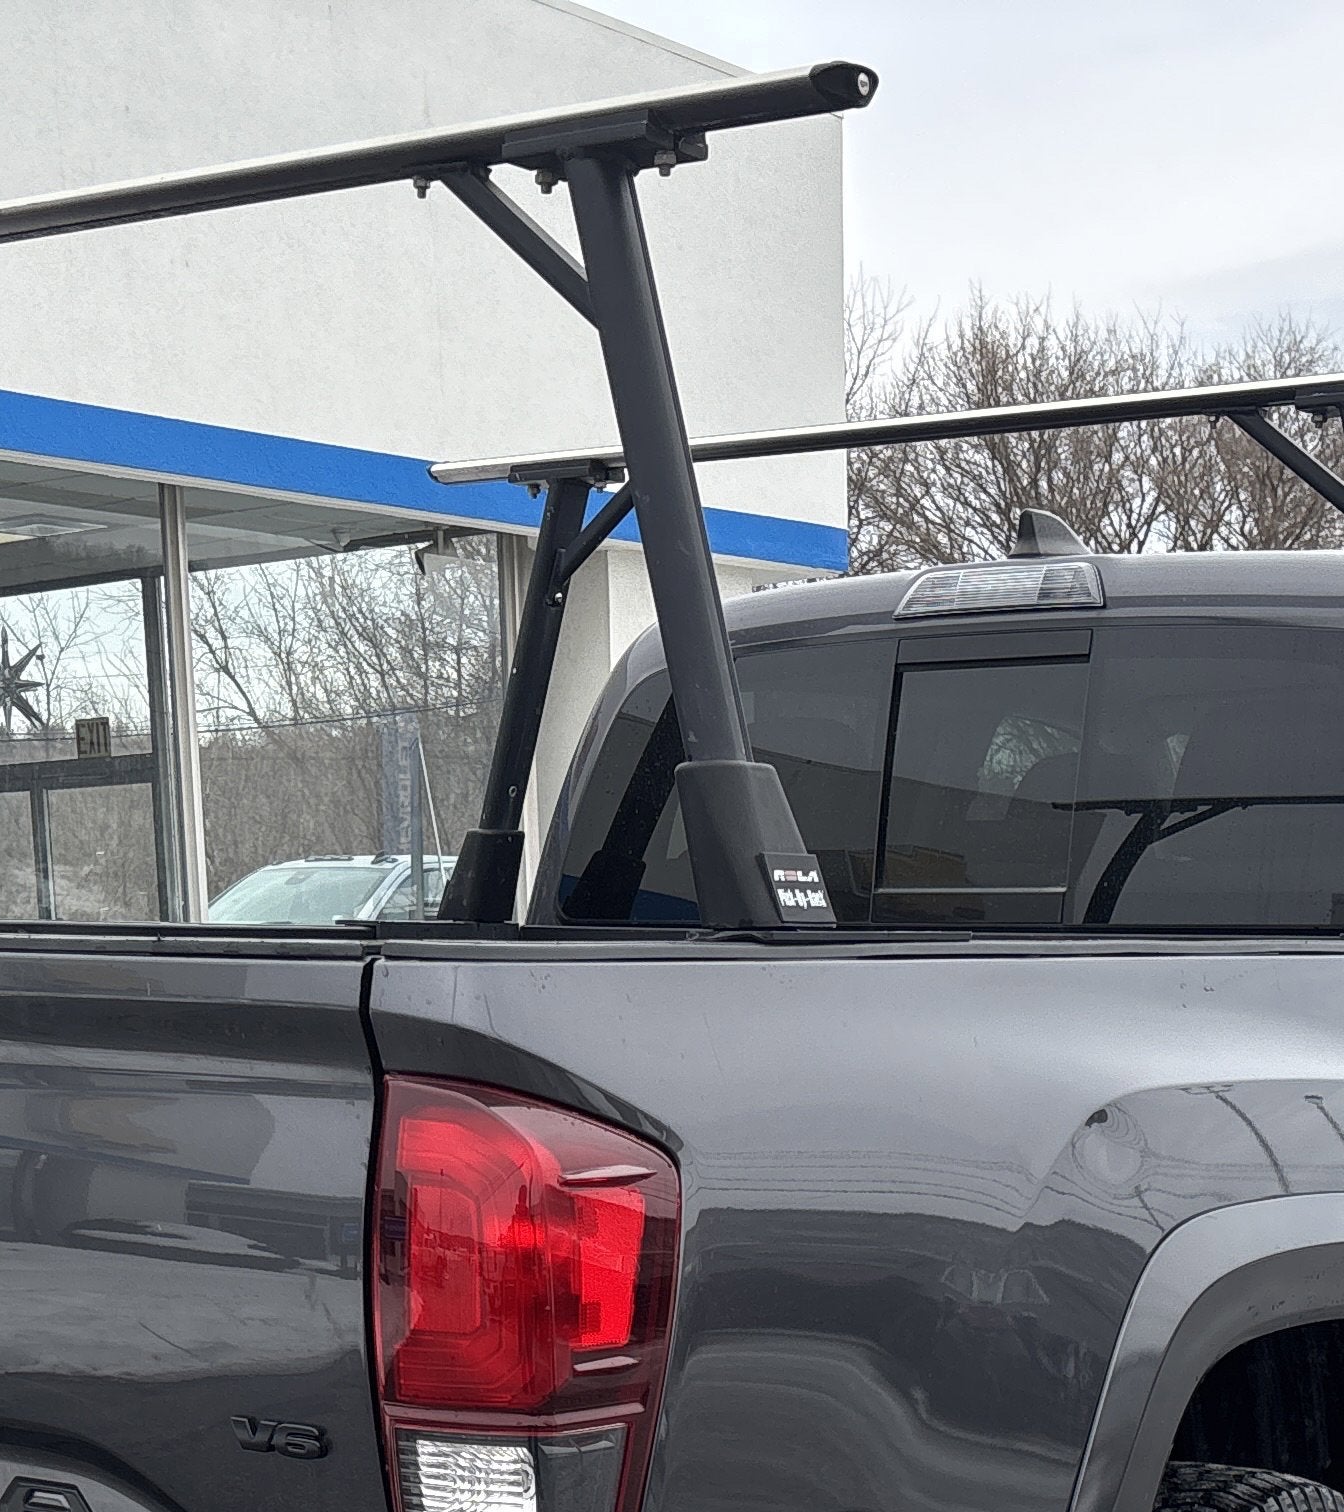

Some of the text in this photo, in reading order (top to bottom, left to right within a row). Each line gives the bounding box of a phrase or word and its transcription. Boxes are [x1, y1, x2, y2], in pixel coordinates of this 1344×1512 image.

[76, 720, 110, 755] EXIT
[773, 869, 819, 882] ROLA
[230, 1415, 328, 1460] V6
